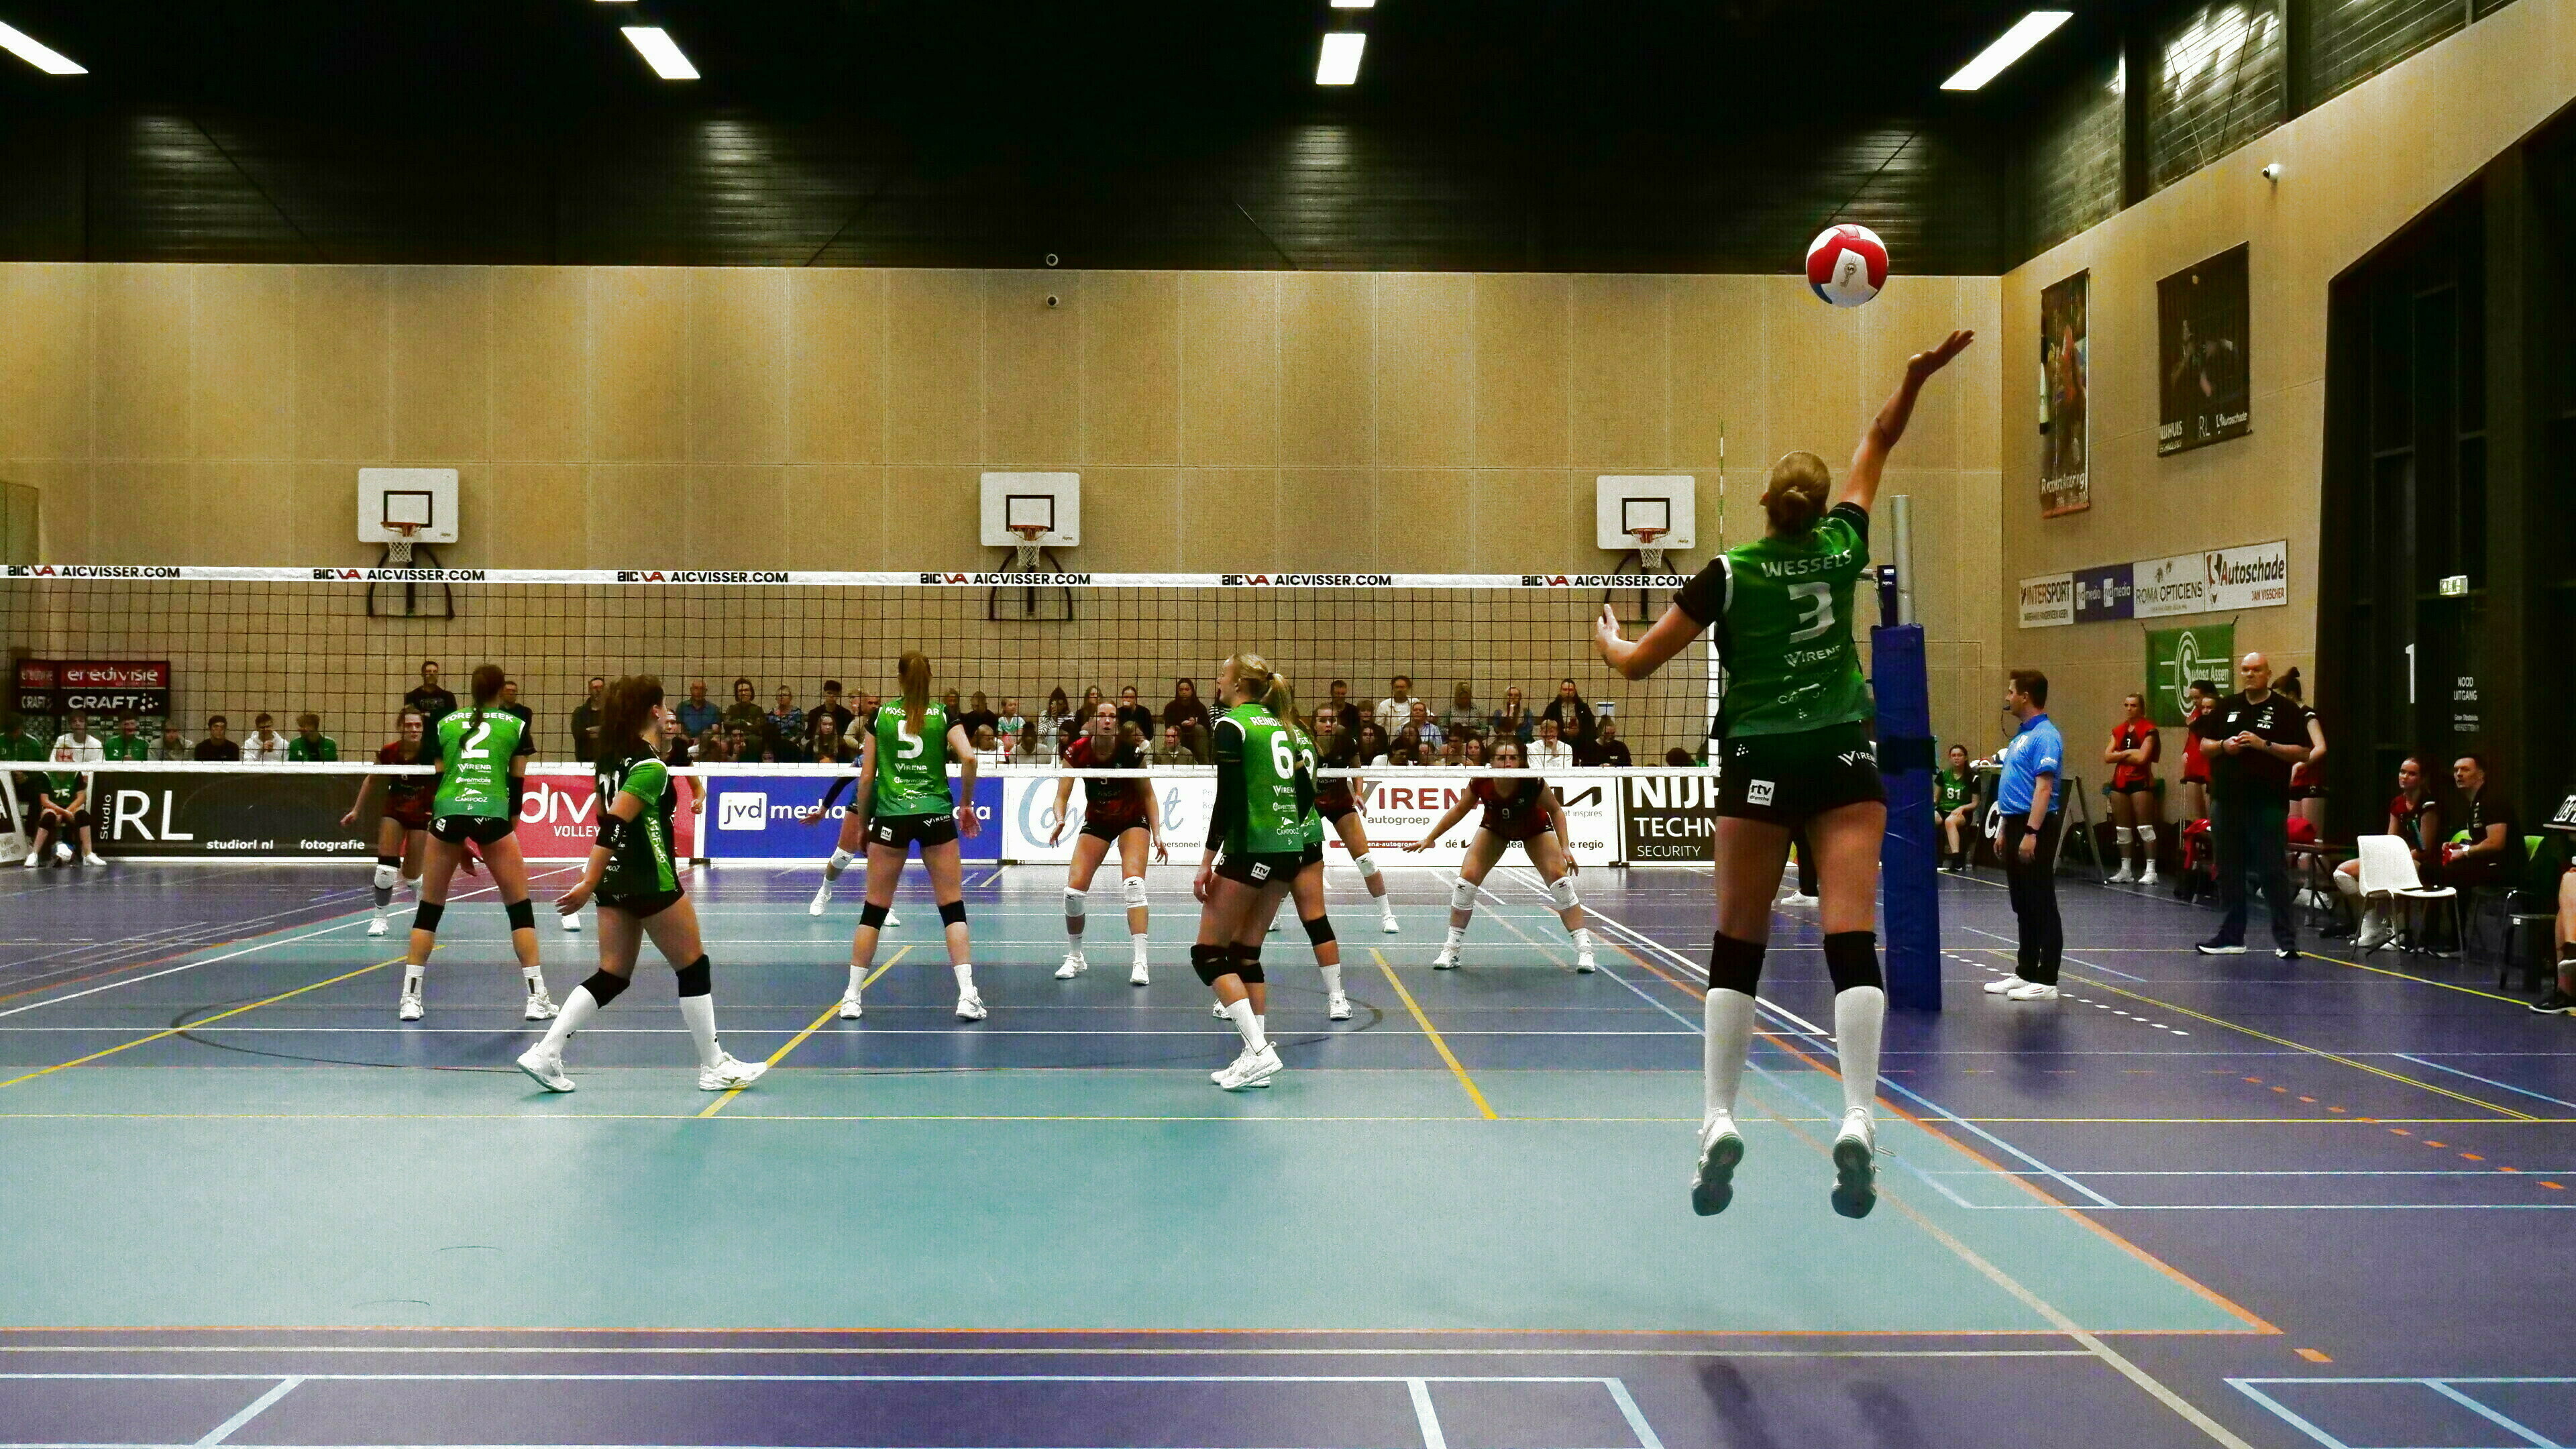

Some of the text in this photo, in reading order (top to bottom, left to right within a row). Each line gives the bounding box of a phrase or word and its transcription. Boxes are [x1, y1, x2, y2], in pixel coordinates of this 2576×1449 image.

[2199, 416, 2210, 438] RL
[1760, 549, 1852, 578] WESSELS
[2221, 553, 2284, 586] Autoschade
[62, 566, 180, 578] AICVISSER.COM
[367, 570, 485, 581] AICVISSER.COM
[671, 572, 788, 583] AICVISSER.COM
[973, 574, 1091, 585] AICVISSER.COM
[1275, 575, 1391, 586] AICVISSER.COM
[1574, 576, 1690, 586] AICVISSER.COM
[2027, 581, 2071, 605] INTERSPORT
[2114, 581, 2131, 597] media
[2136, 581, 2203, 604] ROMA OPTICIENS
[2261, 587, 2284, 600] VISSCHER
[1787, 582, 1835, 644] 3
[67, 667, 158, 682] eredivisie
[2210, 664, 2229, 681] Assen
[2406, 643, 2414, 703] 1
[2457, 677, 2473, 687] NOOD
[2454, 690, 2477, 700] UITGANG
[68, 696, 138, 709] CRAFT
[444, 712, 515, 724] TOREBEEK
[461, 721, 491, 759] 2
[898, 720, 924, 759] 5
[1271, 731, 1294, 780] 6
[458, 763, 492, 773] VIRENA
[895, 763, 928, 772] VIRENA
[1752, 784, 1772, 795] rtv
[1947, 787, 1960, 800] 81
[101, 794, 112, 840] Studio
[113, 790, 194, 840] RL
[724, 798, 763, 824] jvd
[1502, 808, 1509, 819] 9
[1368, 815, 1430, 826] autogroep
[553, 825, 600, 837] VOLLEY
[301, 839, 365, 851] fotografie
[1445, 840, 1458, 849] dé
[1578, 840, 1604, 850] regio
[1637, 845, 1701, 857] SECURITY
[1255, 865, 1268, 874] rtv
